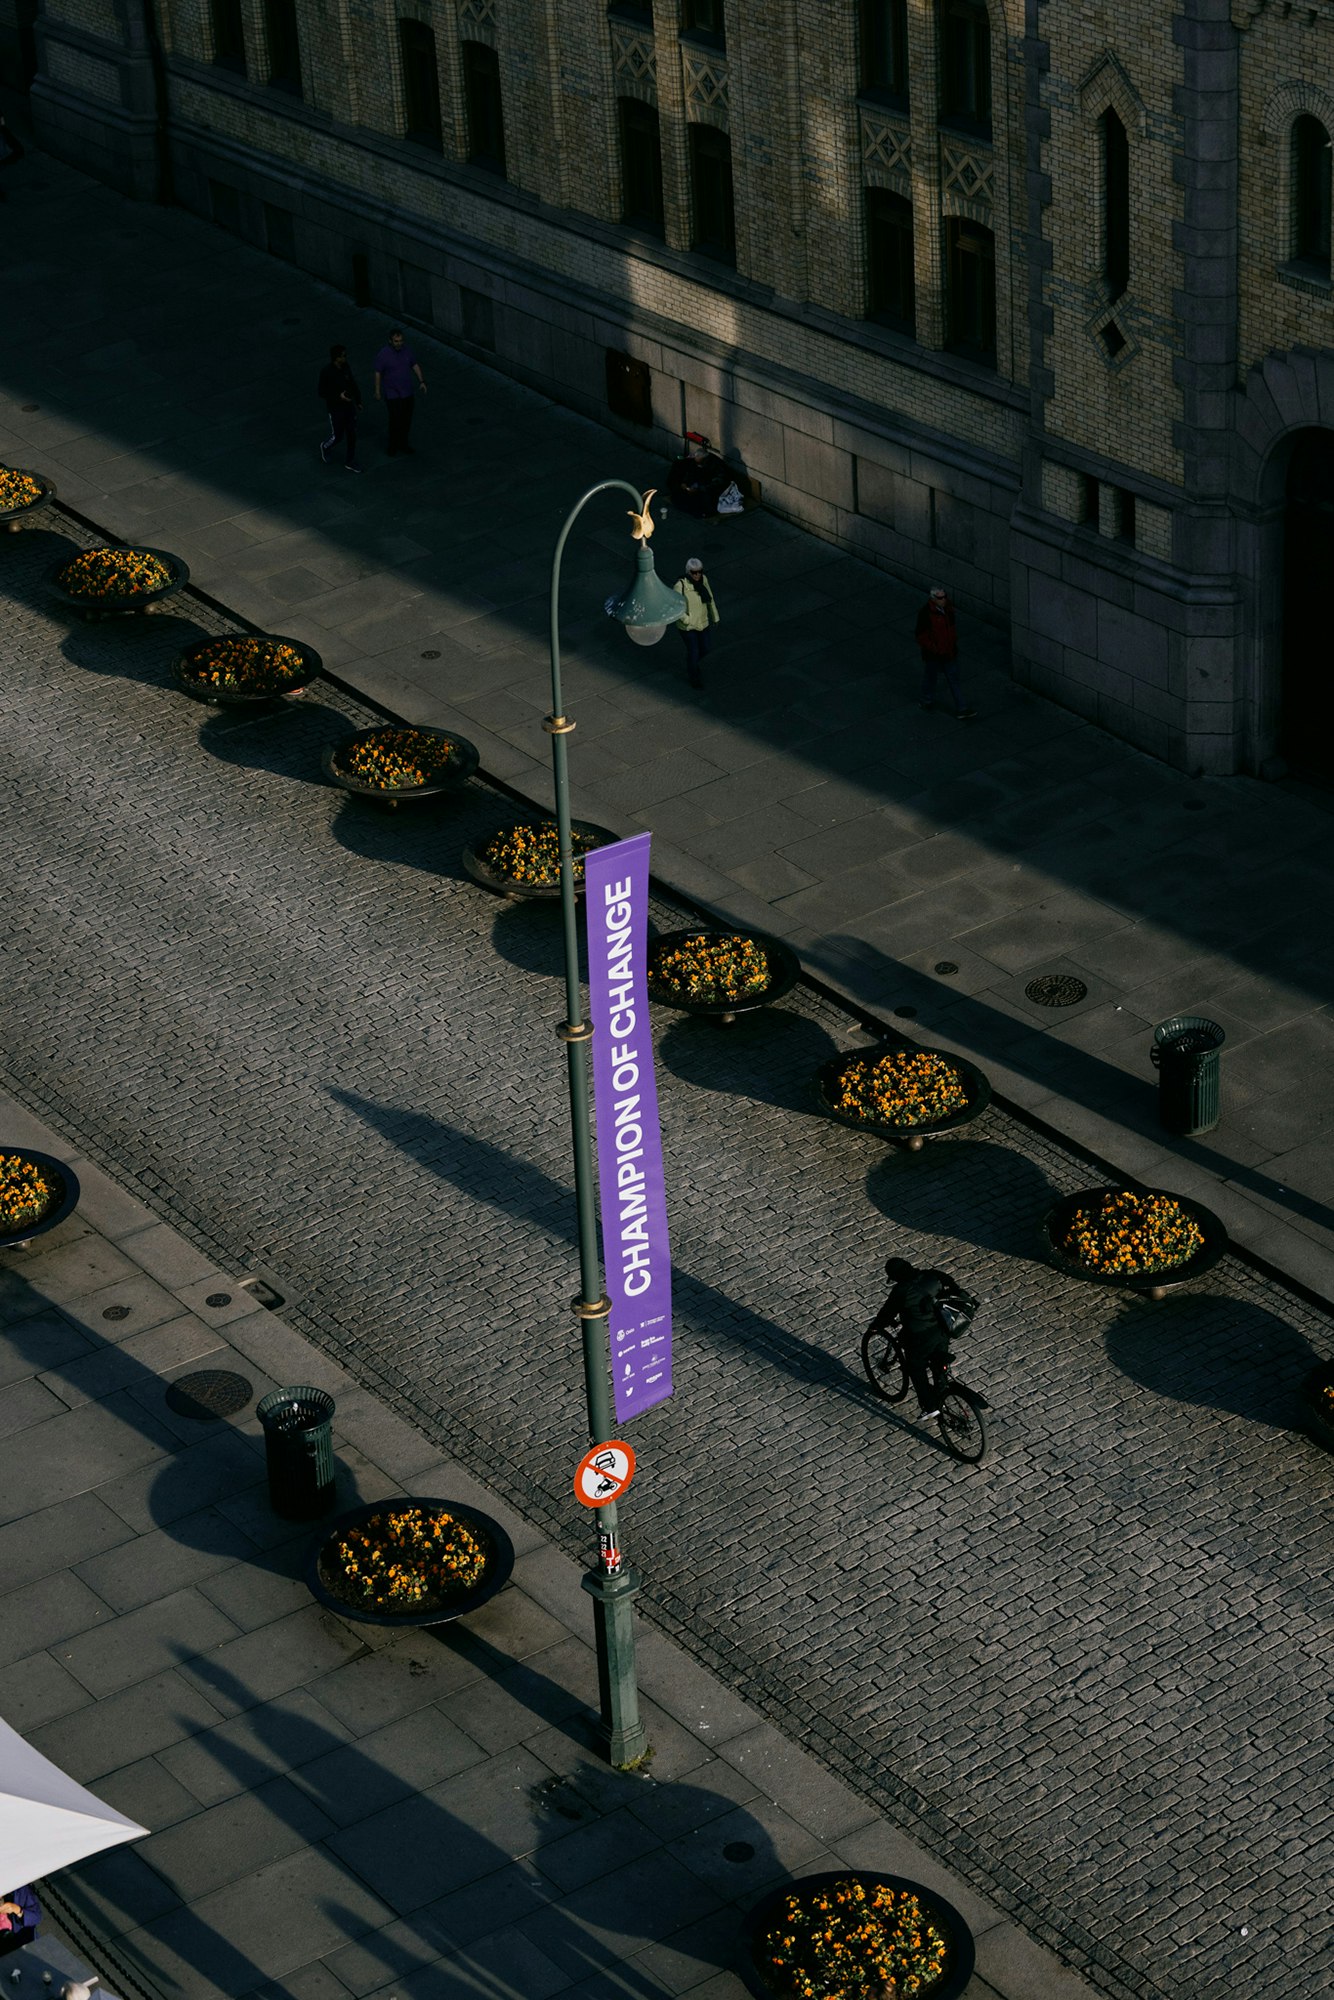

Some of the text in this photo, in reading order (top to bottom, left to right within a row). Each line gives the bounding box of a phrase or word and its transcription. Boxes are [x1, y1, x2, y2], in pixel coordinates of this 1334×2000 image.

[605, 876, 652, 1297] CHAMPION OF CHANGE
